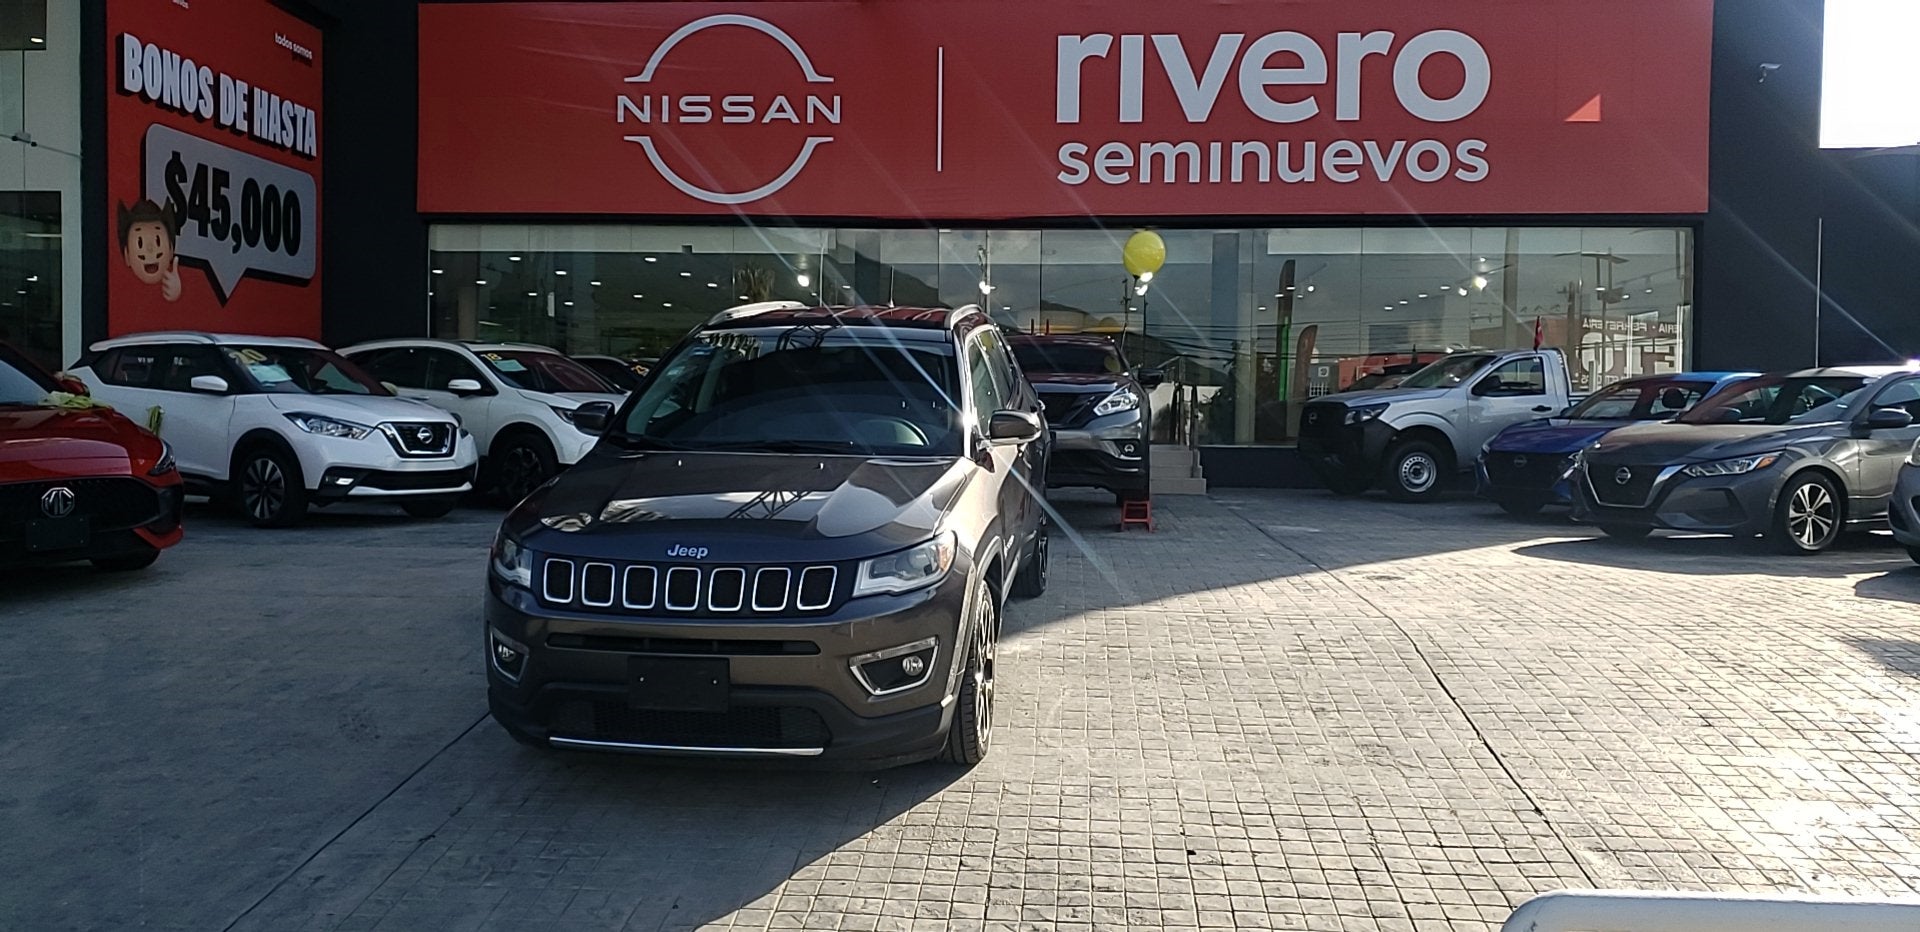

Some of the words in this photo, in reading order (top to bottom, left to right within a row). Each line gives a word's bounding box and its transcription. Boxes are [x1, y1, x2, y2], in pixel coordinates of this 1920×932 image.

[275, 32, 293, 50] todos
[293, 43, 313, 60] somos
[123, 32, 214, 120] BONOS
[219, 72, 249, 134] DE
[253, 86, 317, 158] HASTA
[1056, 29, 1491, 124] rivero
[616, 94, 842, 124] NISSAN
[1056, 138, 1490, 185] seminuevos
[164, 150, 302, 257] $45,000
[42, 488, 74, 517] MG
[667, 544, 709, 560] Jeep
